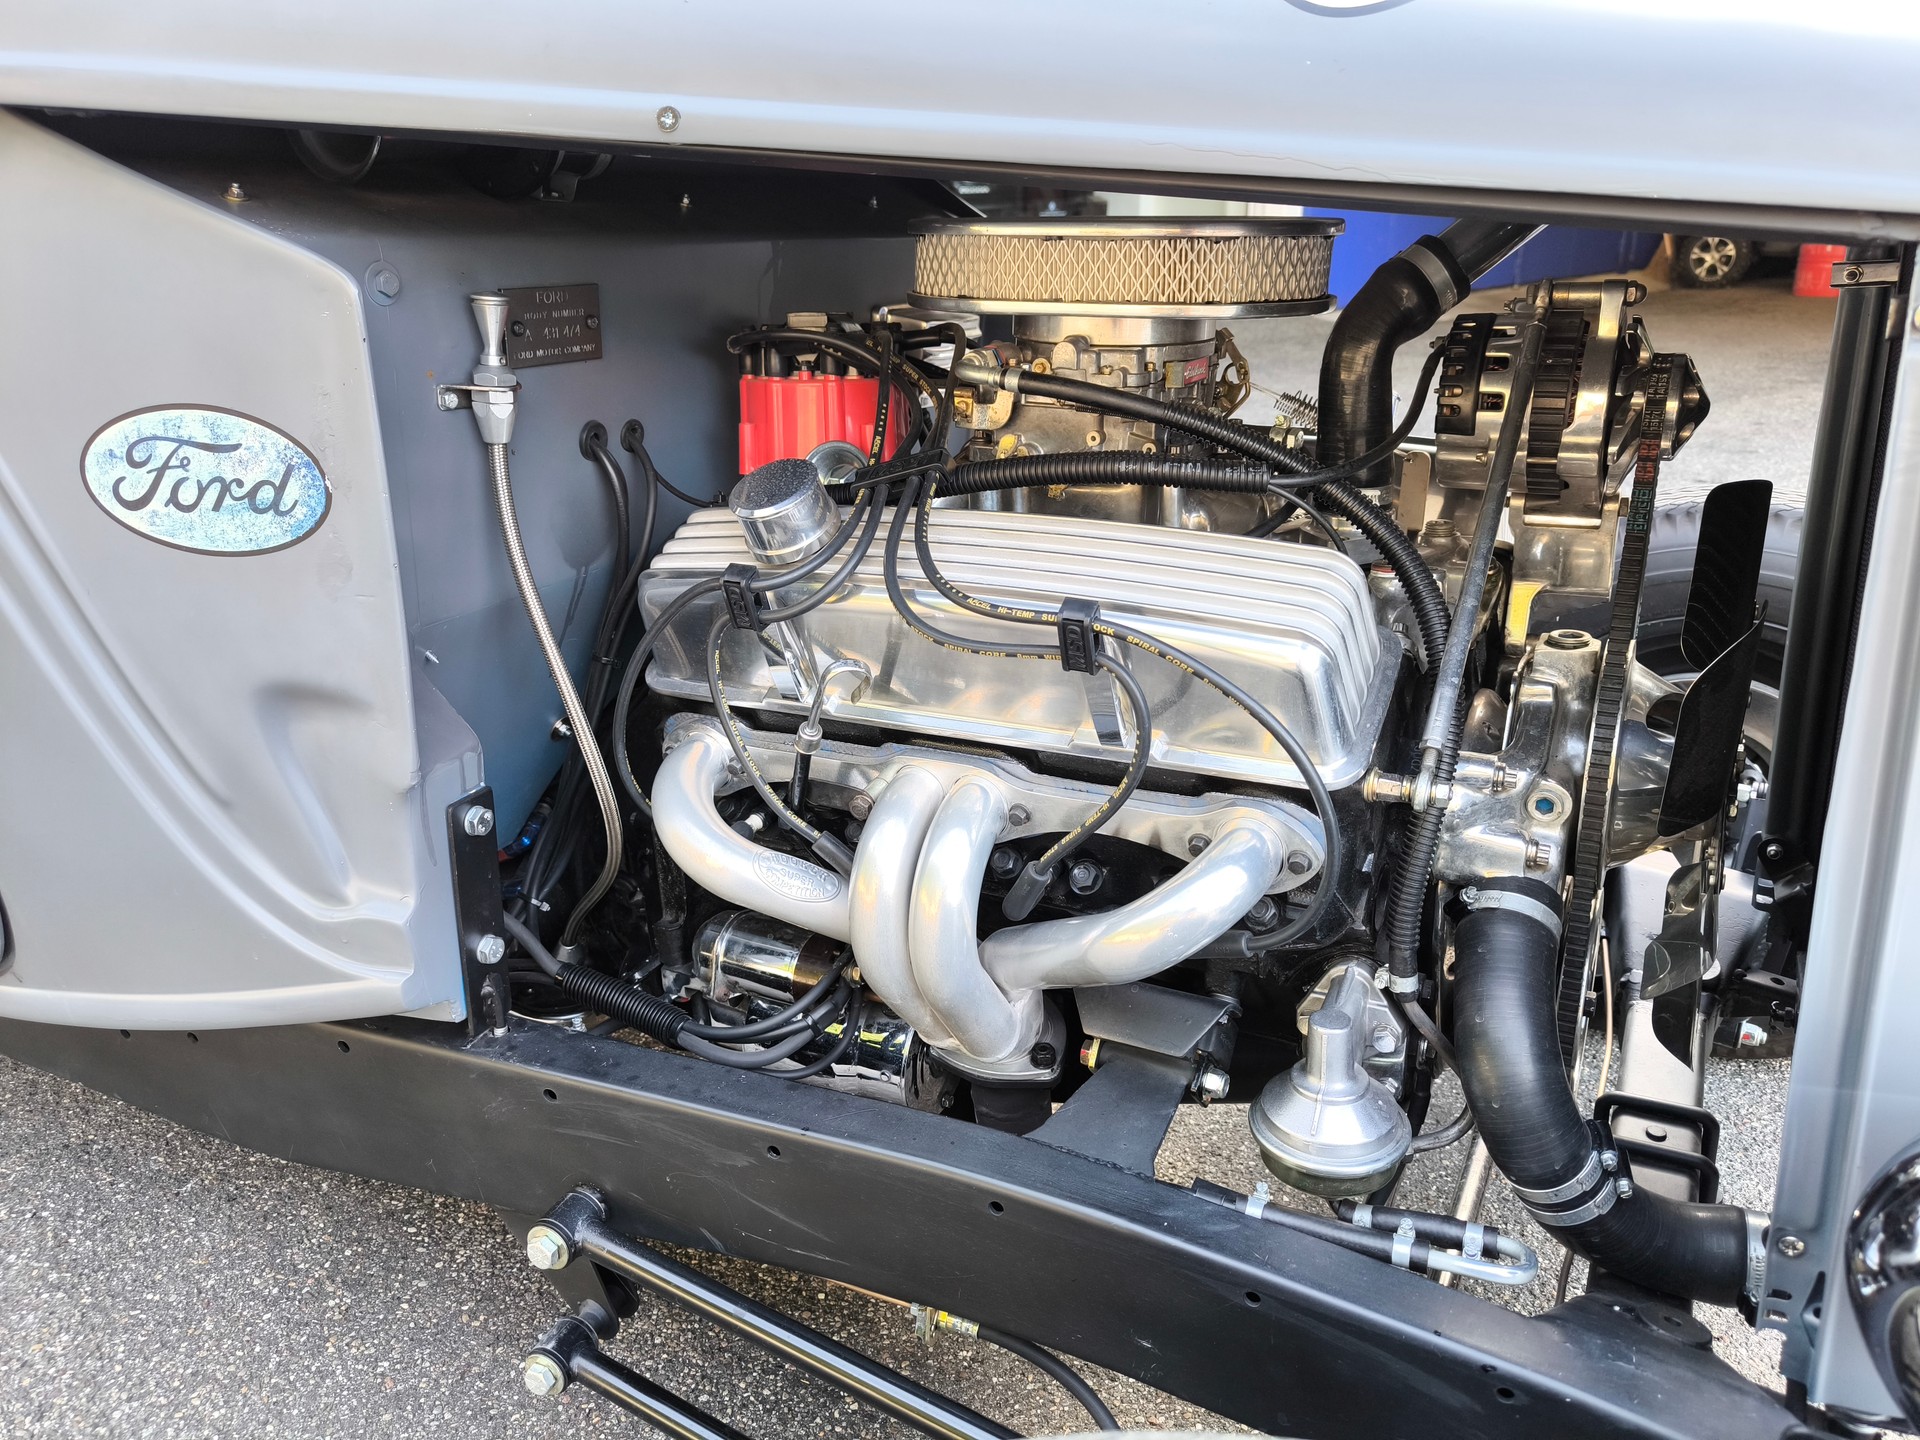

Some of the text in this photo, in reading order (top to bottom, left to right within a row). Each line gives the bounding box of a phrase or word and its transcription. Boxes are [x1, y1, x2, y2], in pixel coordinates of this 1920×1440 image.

[536, 291, 569, 304] FORD
[552, 308, 585, 319] NUMBER
[524, 329, 533, 342] A
[513, 344, 596, 360] FORD MOTOR COMPANY
[112, 435, 299, 517] Ford
[966, 597, 992, 611] ACCEL
[997, 606, 1036, 619] HI-TEMP
[1091, 622, 1115, 636] OCK
[1126, 635, 1160, 656] SPIRAL
[1165, 655, 1194, 675] CORE
[1065, 624, 1087, 669] MSD
[729, 719, 745, 747] SUPER
[744, 751, 762, 777] STOCK
[764, 784, 785, 809] SPIRAL
[786, 810, 807, 828] CORE
[1061, 825, 1082, 845] SUPER
[765, 868, 825, 898] COMPETITION
[780, 868, 815, 887] SUPER
